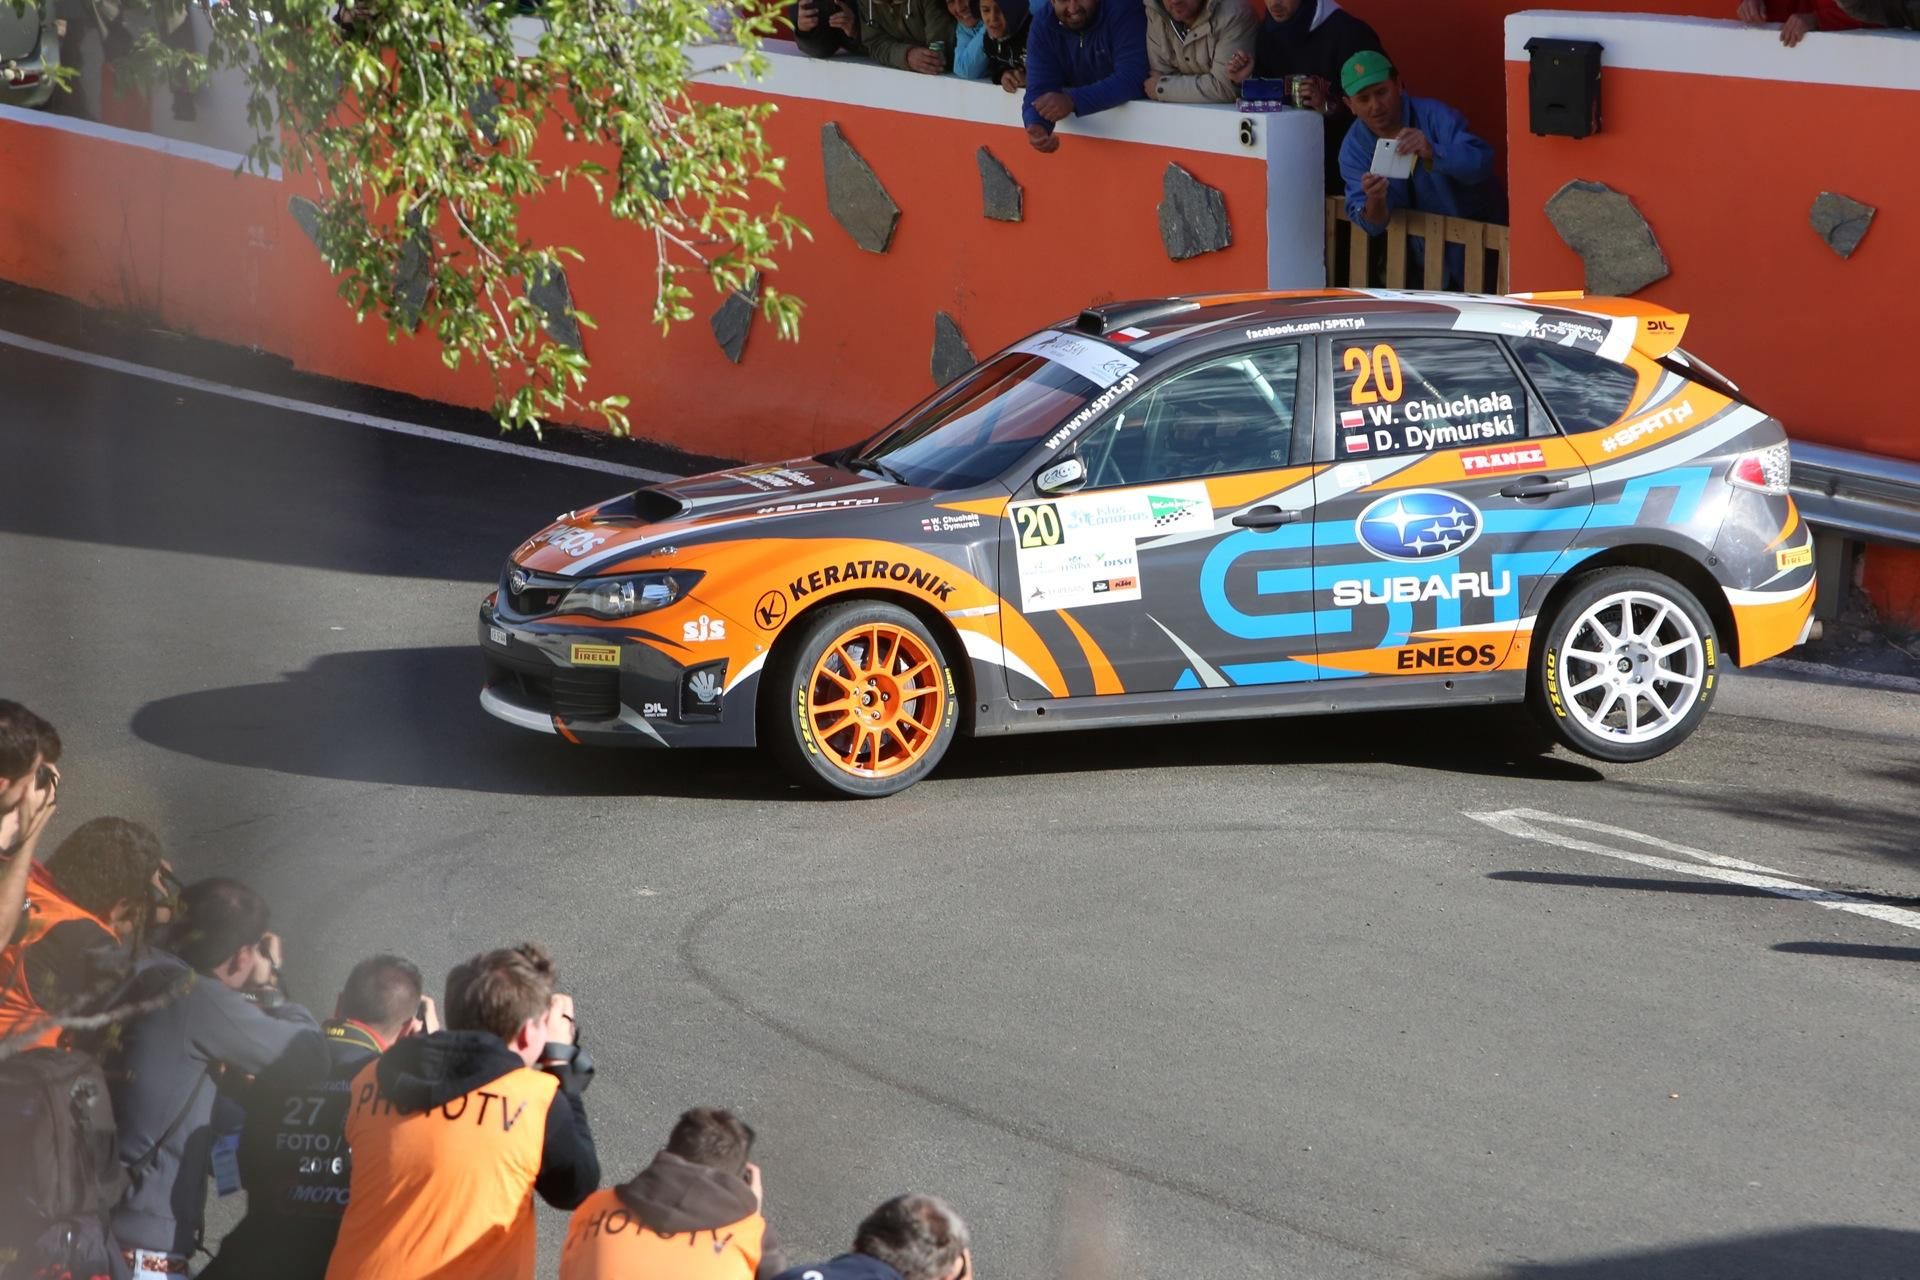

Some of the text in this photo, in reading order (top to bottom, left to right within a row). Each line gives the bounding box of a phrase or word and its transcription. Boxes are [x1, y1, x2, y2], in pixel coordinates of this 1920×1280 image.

[1240, 118, 1256, 146] 6
[1246, 317, 1366, 339] facebook.com/SPRTpl
[1343, 343, 1403, 405] 20
[1045, 373, 1139, 450] www.sprt.pl
[1368, 391, 1513, 428] W. Chuchała
[1374, 416, 1515, 451] D. Dymurski
[1461, 449, 1544, 471] FRANKE
[1017, 504, 1061, 547] 20
[788, 560, 956, 602] KERATRONIK
[1333, 571, 1511, 606] SUBARU
[574, 647, 616, 662] PIRELLI
[1398, 645, 1496, 669] ENEOS
[283, 1096, 325, 1126] 27
[276, 1133, 330, 1151] FOTO
[299, 1156, 342, 1174] 2016
